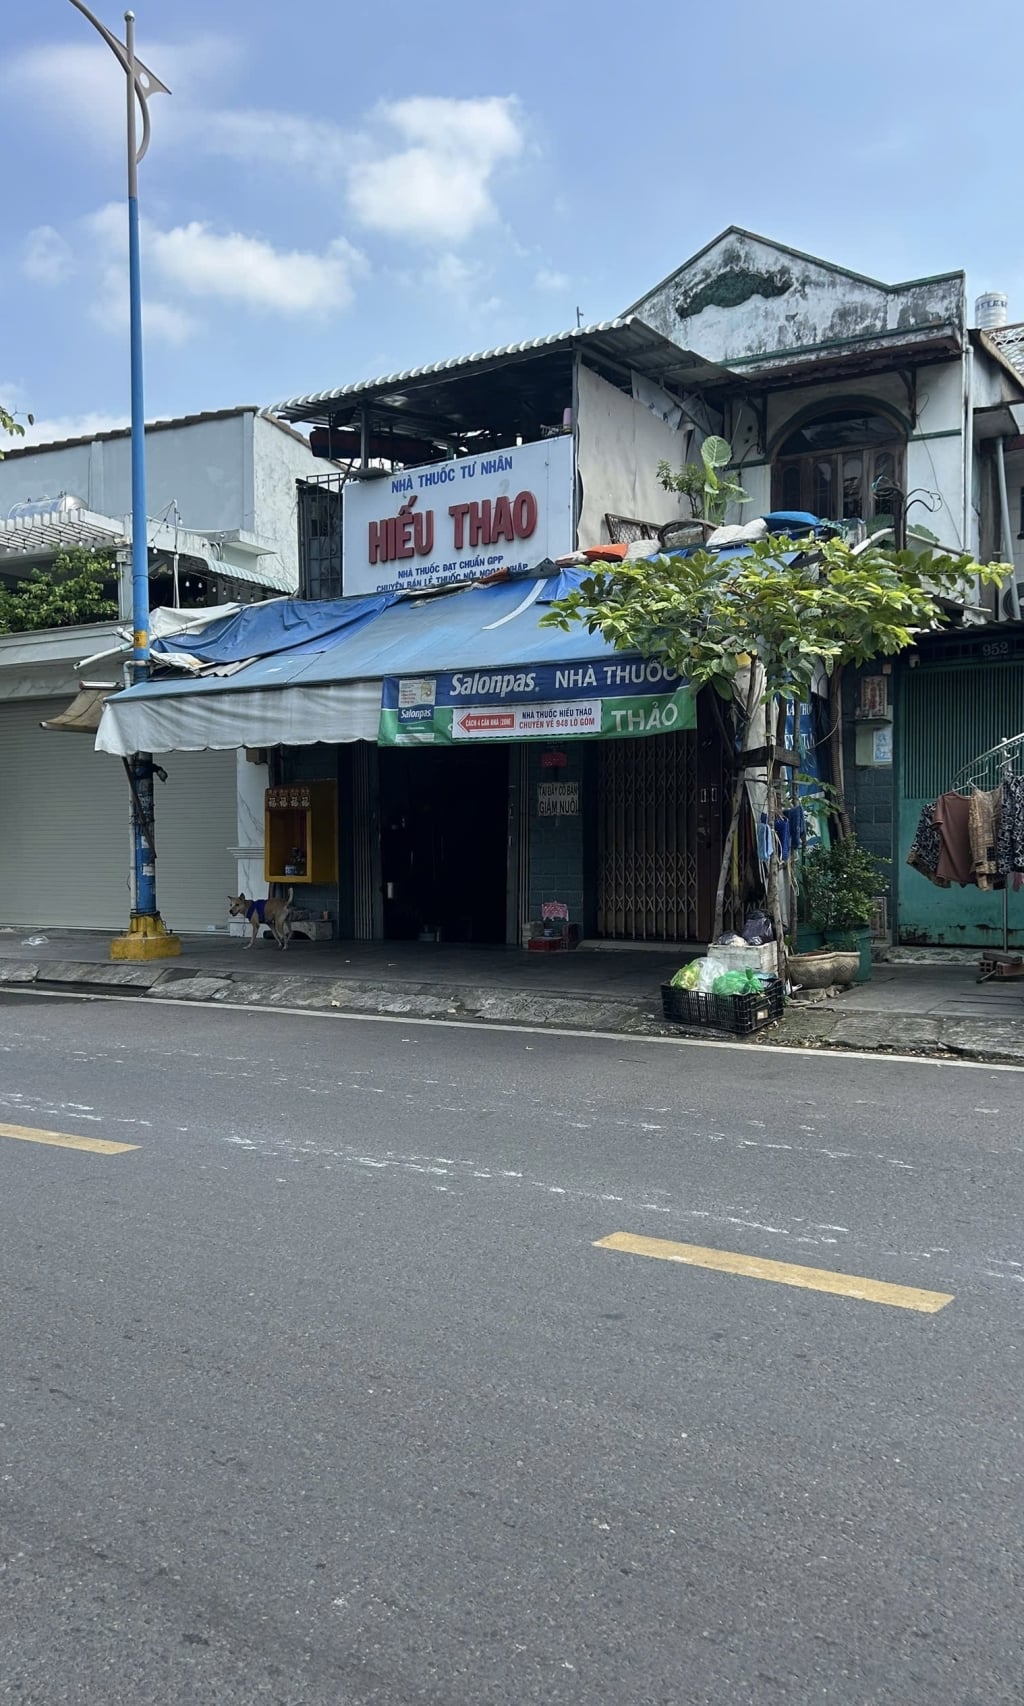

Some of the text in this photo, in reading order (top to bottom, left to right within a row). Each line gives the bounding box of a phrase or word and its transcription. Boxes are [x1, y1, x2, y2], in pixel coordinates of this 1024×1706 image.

[391, 455, 513, 494] NHÀ THUỐC TƯ NHÂN
[368, 495, 434, 565] HIẾU
[398, 554, 504, 579] NHÀ THUỐC ĐẠT CHUẨN GPP
[982, 641, 1009, 657] 952
[450, 672, 537, 697] Salonpas
[555, 664, 597, 689] NHÀ
[400, 708, 432, 720] Salonpas
[522, 709, 535, 719] NHÀ
[536, 707, 558, 719] THUỐC
[559, 706, 574, 718] HIẾU
[556, 719, 569, 728] 948
[610, 701, 679, 732] THẢO
